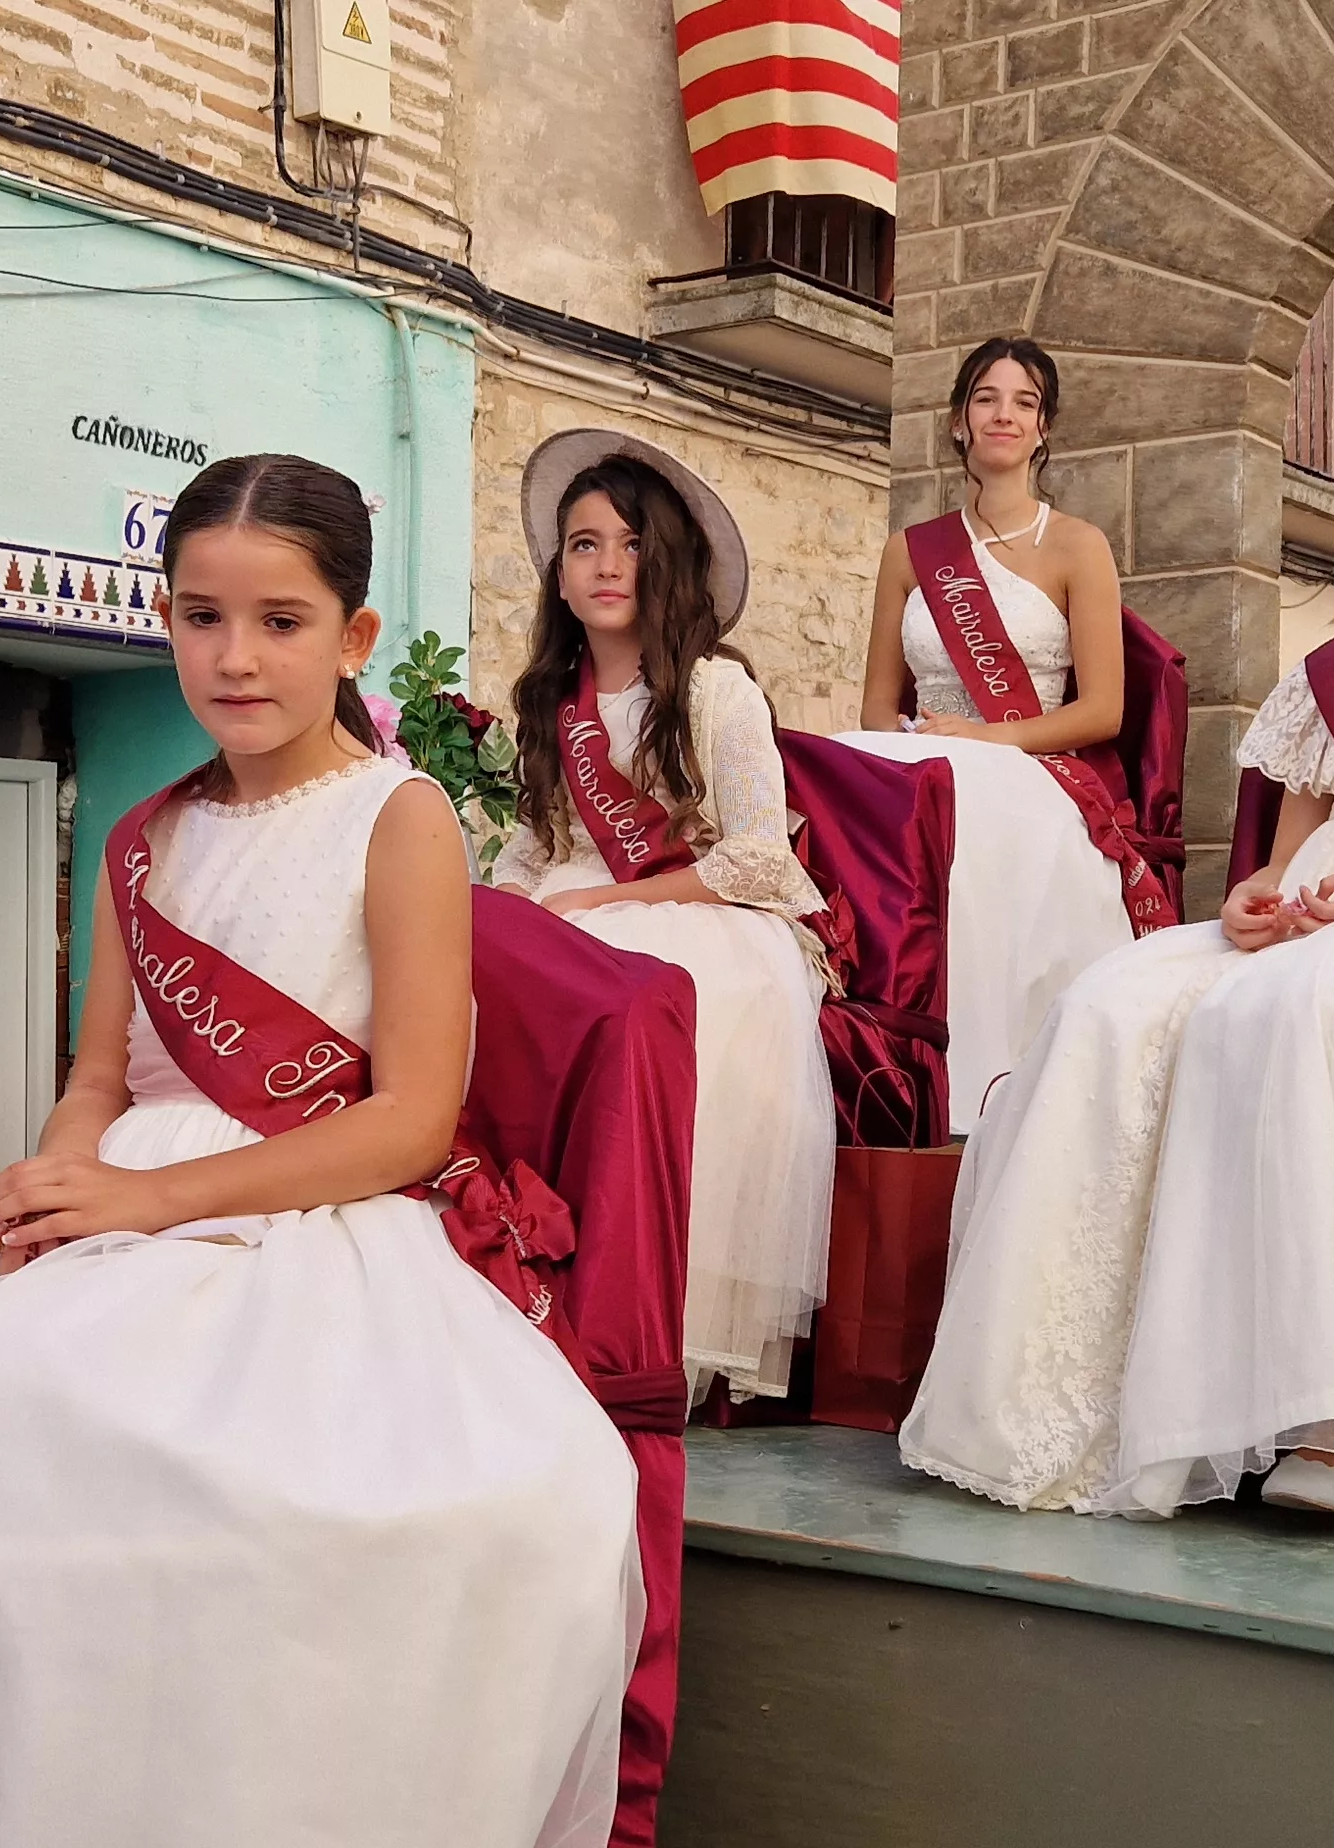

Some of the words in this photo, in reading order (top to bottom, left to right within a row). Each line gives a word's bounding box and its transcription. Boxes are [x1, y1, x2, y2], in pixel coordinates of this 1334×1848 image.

[71, 414, 208, 467] CAÑONEROS
[124, 501, 171, 555] 67
[935, 565, 1011, 698] Mairalesa
[562, 704, 651, 864] Mairalesa
